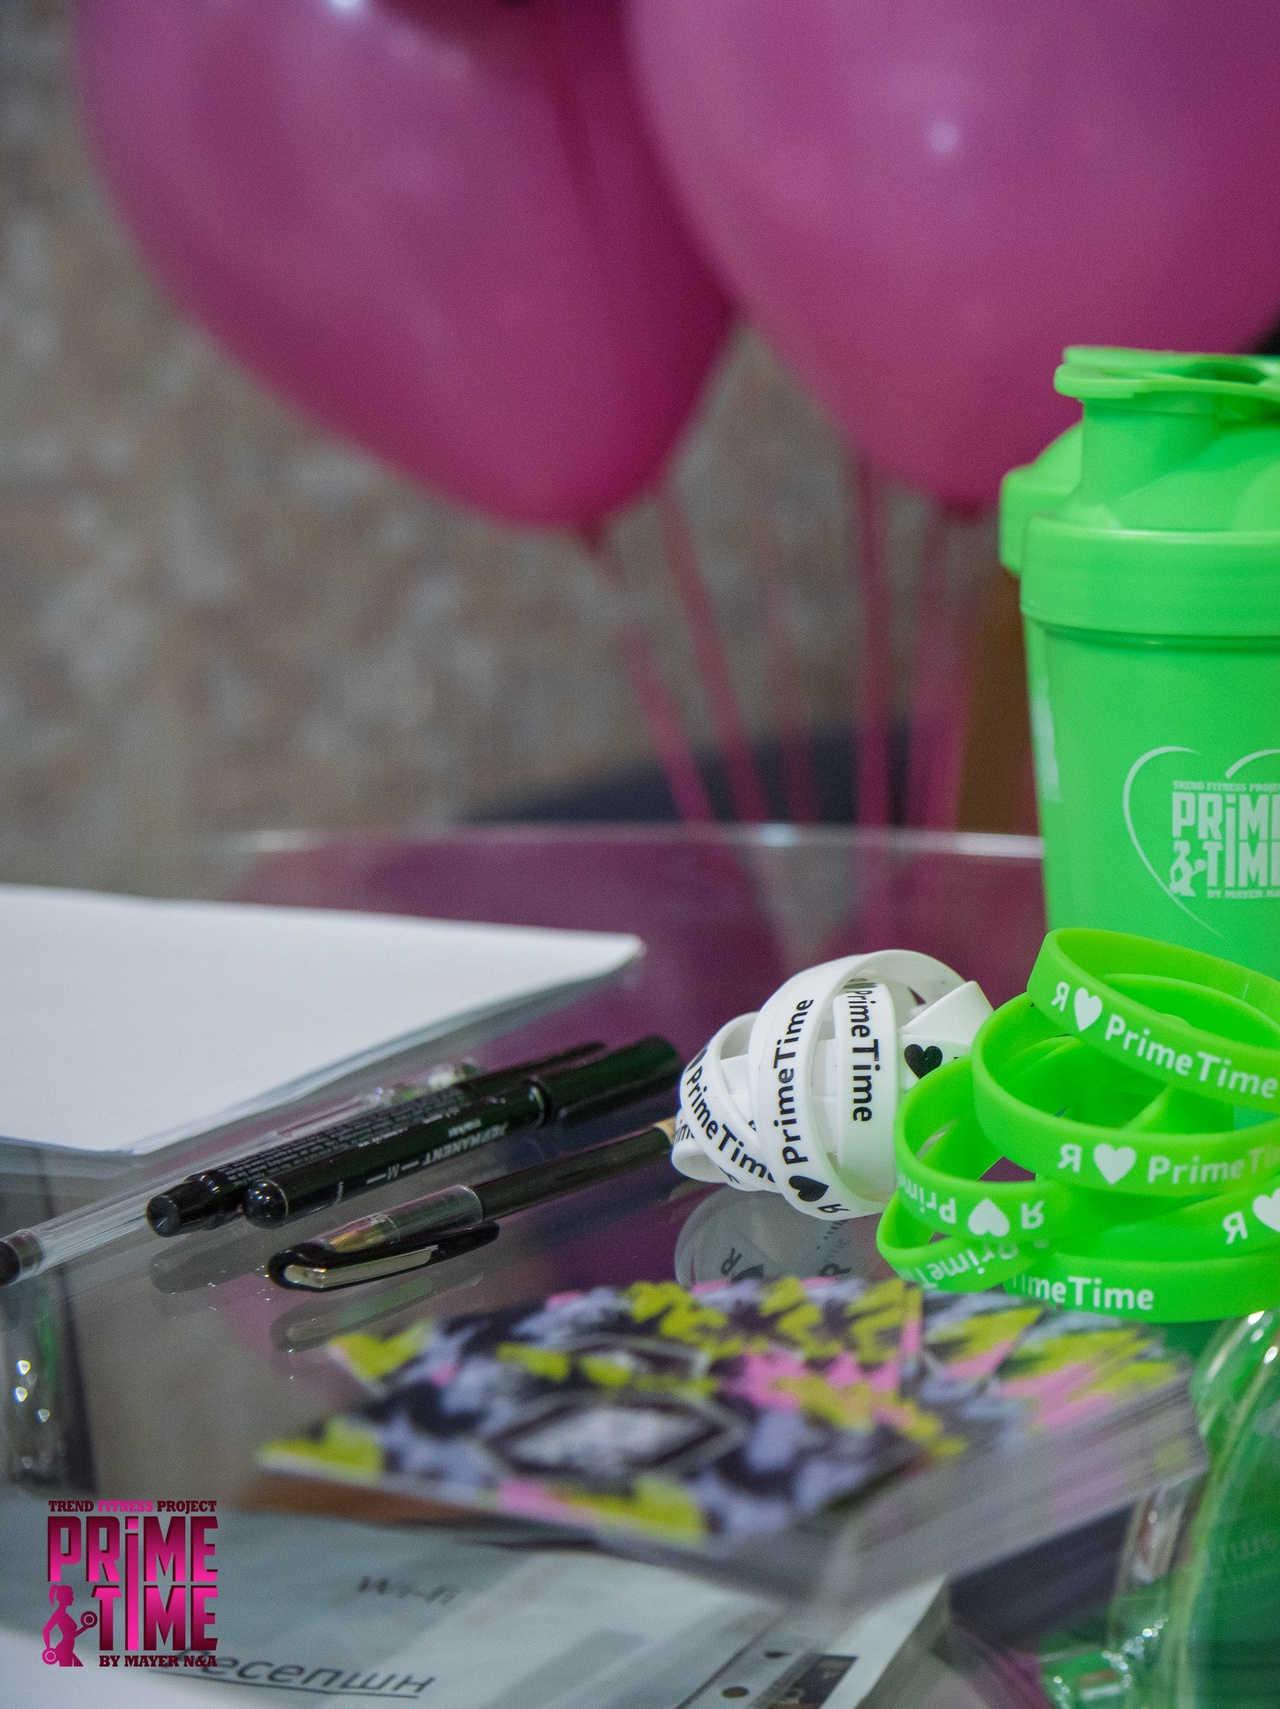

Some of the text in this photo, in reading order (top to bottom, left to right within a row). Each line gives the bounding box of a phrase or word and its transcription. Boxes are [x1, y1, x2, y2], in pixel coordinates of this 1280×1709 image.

[773, 998, 814, 1165] PrimeTime
[847, 989, 880, 1123] PrimeTime
[1051, 981, 1279, 1099] Я PrimeTime
[1057, 1143, 1083, 1173] Я
[1222, 1211, 1248, 1245] Я
